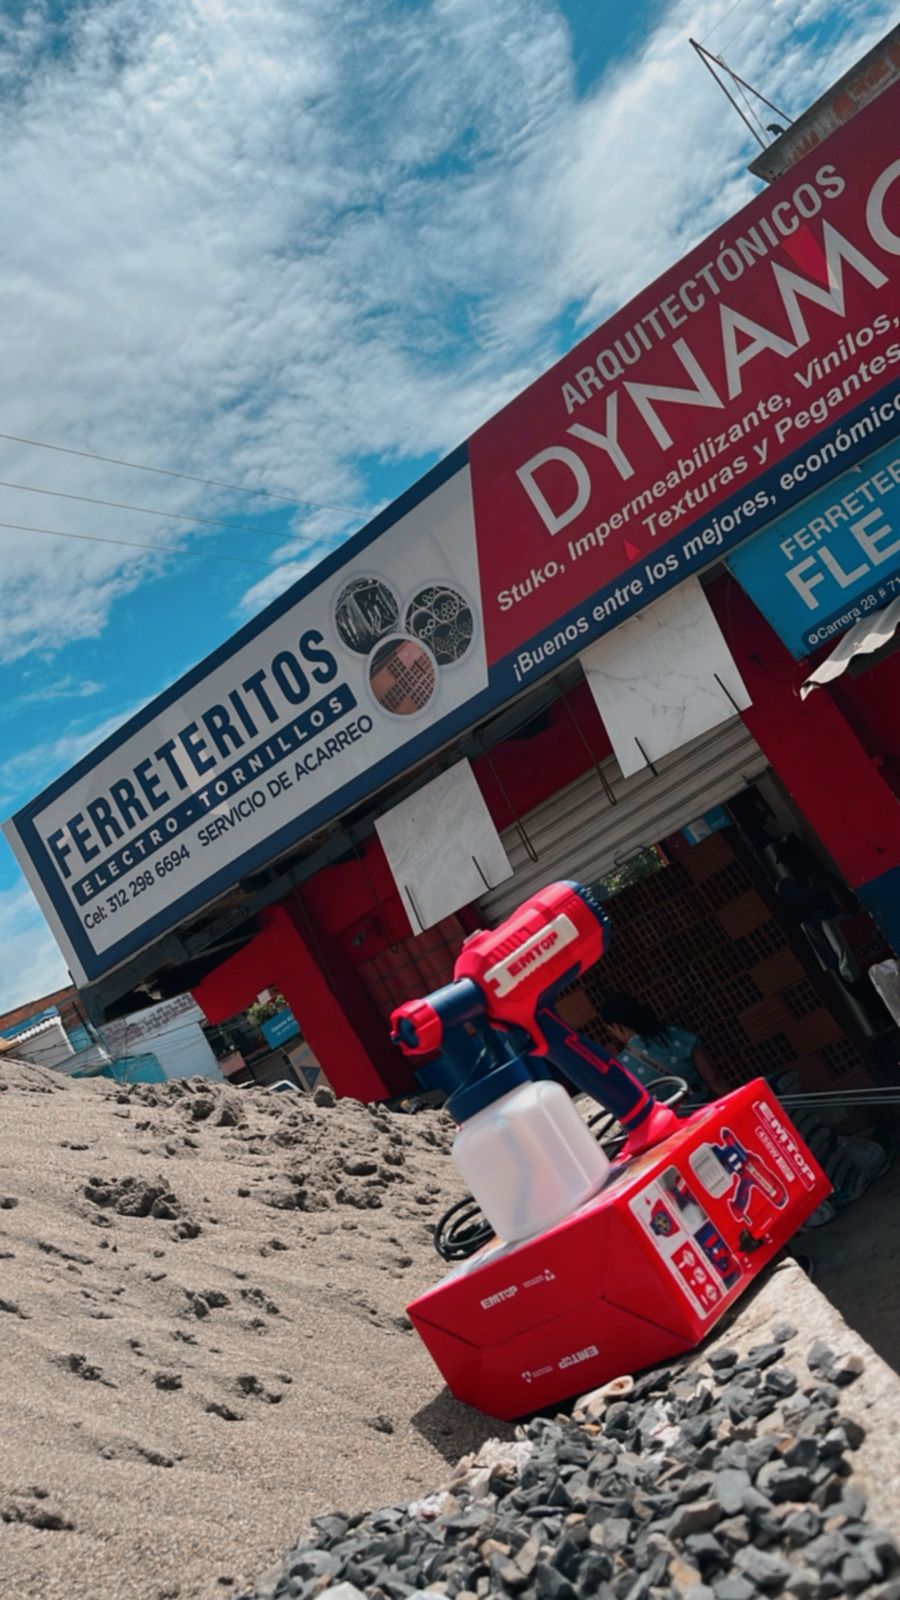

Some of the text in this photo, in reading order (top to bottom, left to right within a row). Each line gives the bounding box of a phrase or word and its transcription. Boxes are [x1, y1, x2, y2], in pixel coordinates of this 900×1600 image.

[560, 164, 846, 414] ARQUITECTÓNICOS
[497, 314, 899, 611] Stuko, Impermeabilizante, Vinilos,
[641, 456, 748, 537] Texturas
[753, 438, 768, 465] y
[513, 616, 589, 683] ¡Buenos
[592, 579, 643, 621] entre
[645, 554, 679, 585] los
[682, 490, 776, 560] mejores,
[860, 594, 878, 612] 28
[47, 629, 338, 879] FERRETERITOS
[84, 715, 373, 930] Cel: 312 298 6694 SERVICIO DE ACARREO
[507, 930, 558, 977] EMTOP
[758, 1101, 816, 1181] EMTOP
[480, 1285, 518, 1310] EMTOP
[558, 1345, 599, 1370] EMTOP
